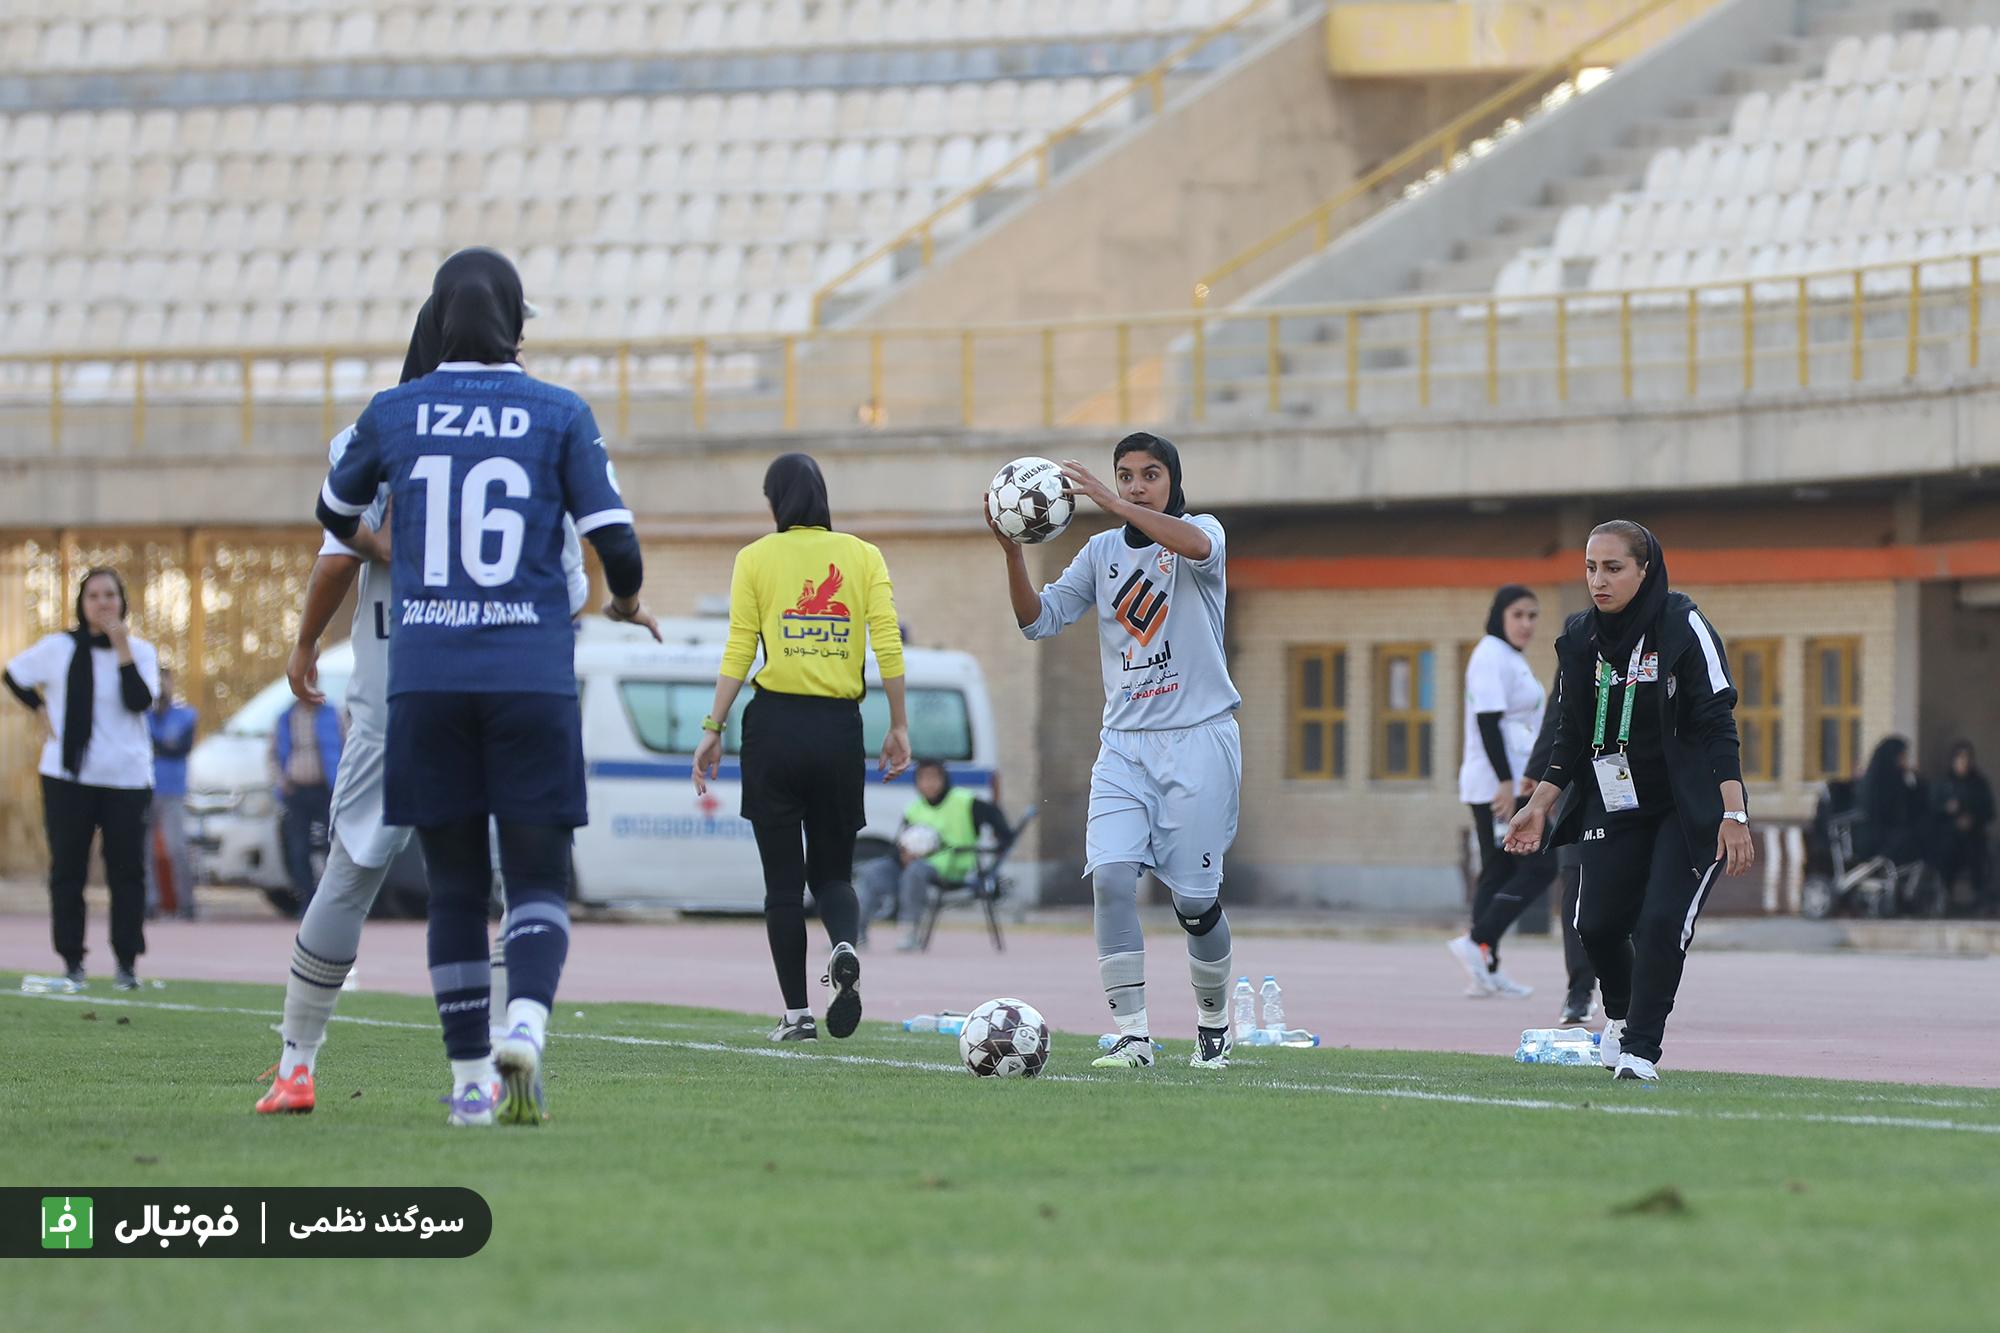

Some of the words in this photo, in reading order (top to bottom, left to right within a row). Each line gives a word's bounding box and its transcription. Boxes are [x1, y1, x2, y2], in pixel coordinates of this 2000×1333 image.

[416, 403, 531, 438] IZAD
[409, 455, 532, 587] 16
[784, 622, 850, 643] پارس
[784, 645, 819, 657] خودرو
[820, 646, 849, 660] روغن
[1583, 828, 1606, 841] M.B
